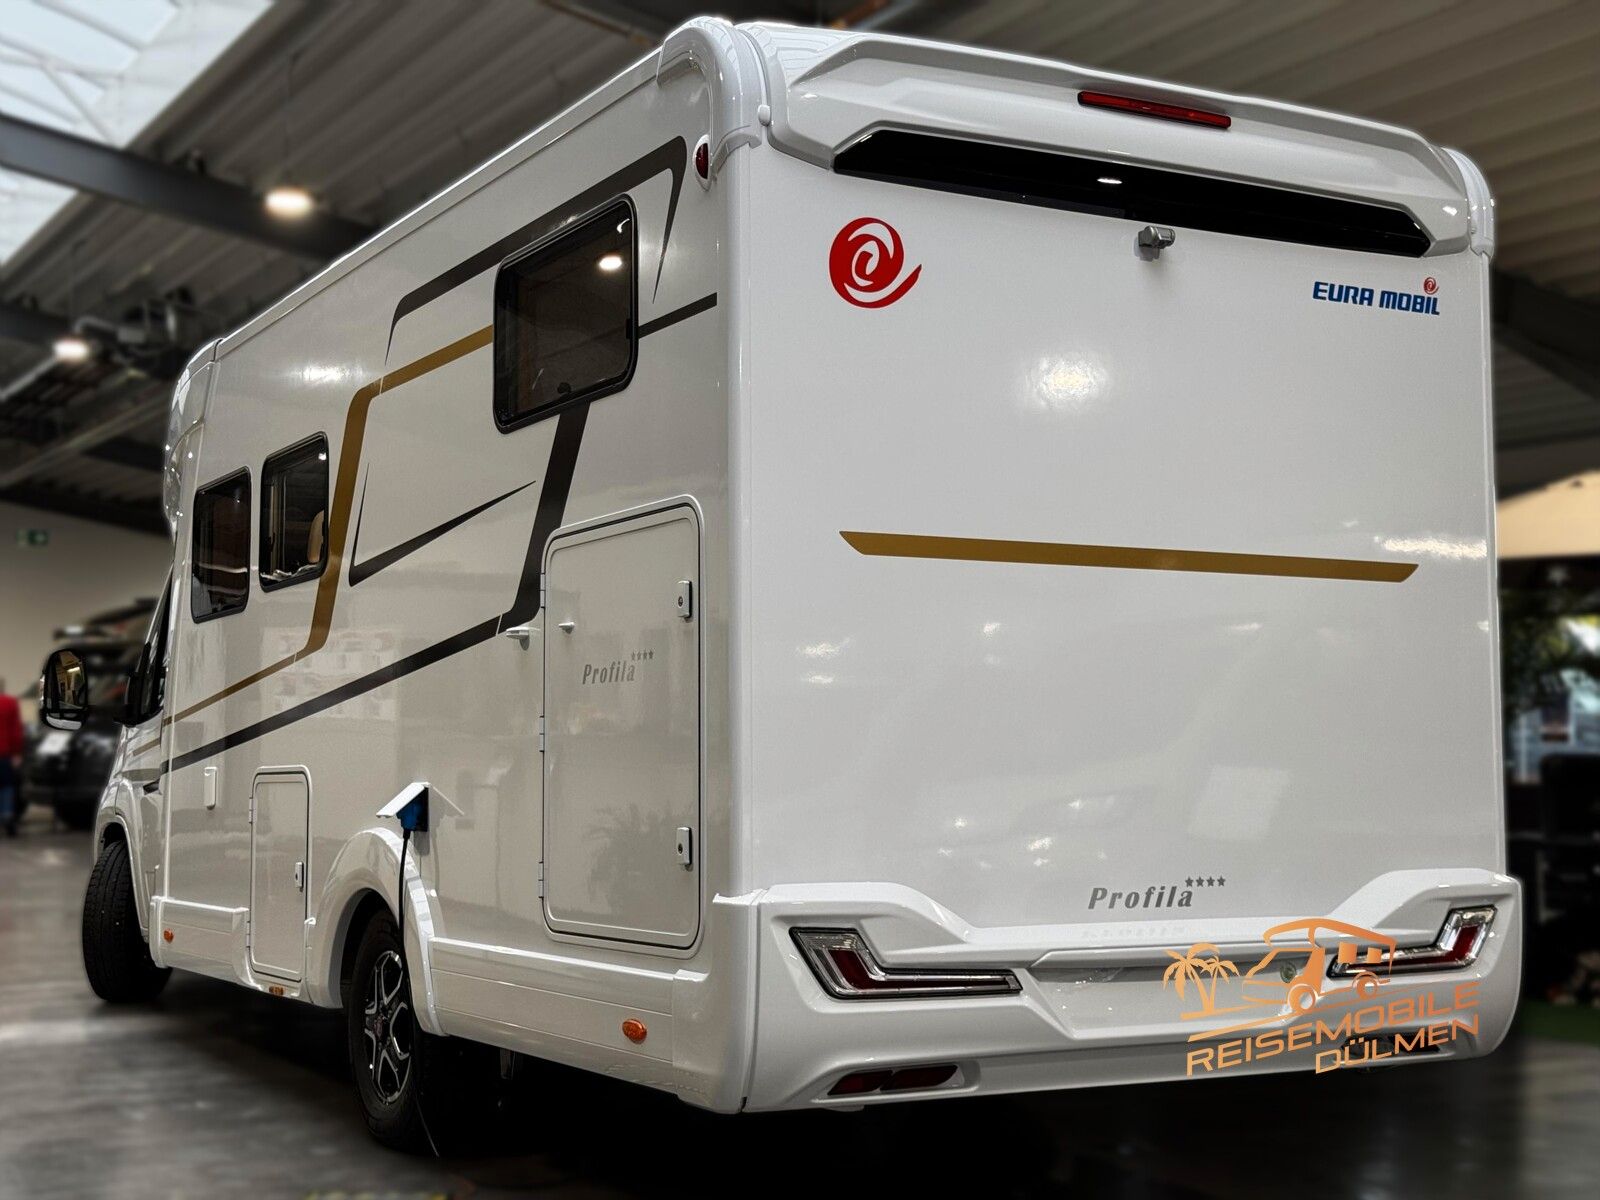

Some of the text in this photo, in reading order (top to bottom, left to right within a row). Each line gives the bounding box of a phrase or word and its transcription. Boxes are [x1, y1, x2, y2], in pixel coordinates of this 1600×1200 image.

[1313, 281, 1440, 315] EURA MOBIL
[582, 661, 636, 685] Profila
[1088, 886, 1193, 910] Profila
